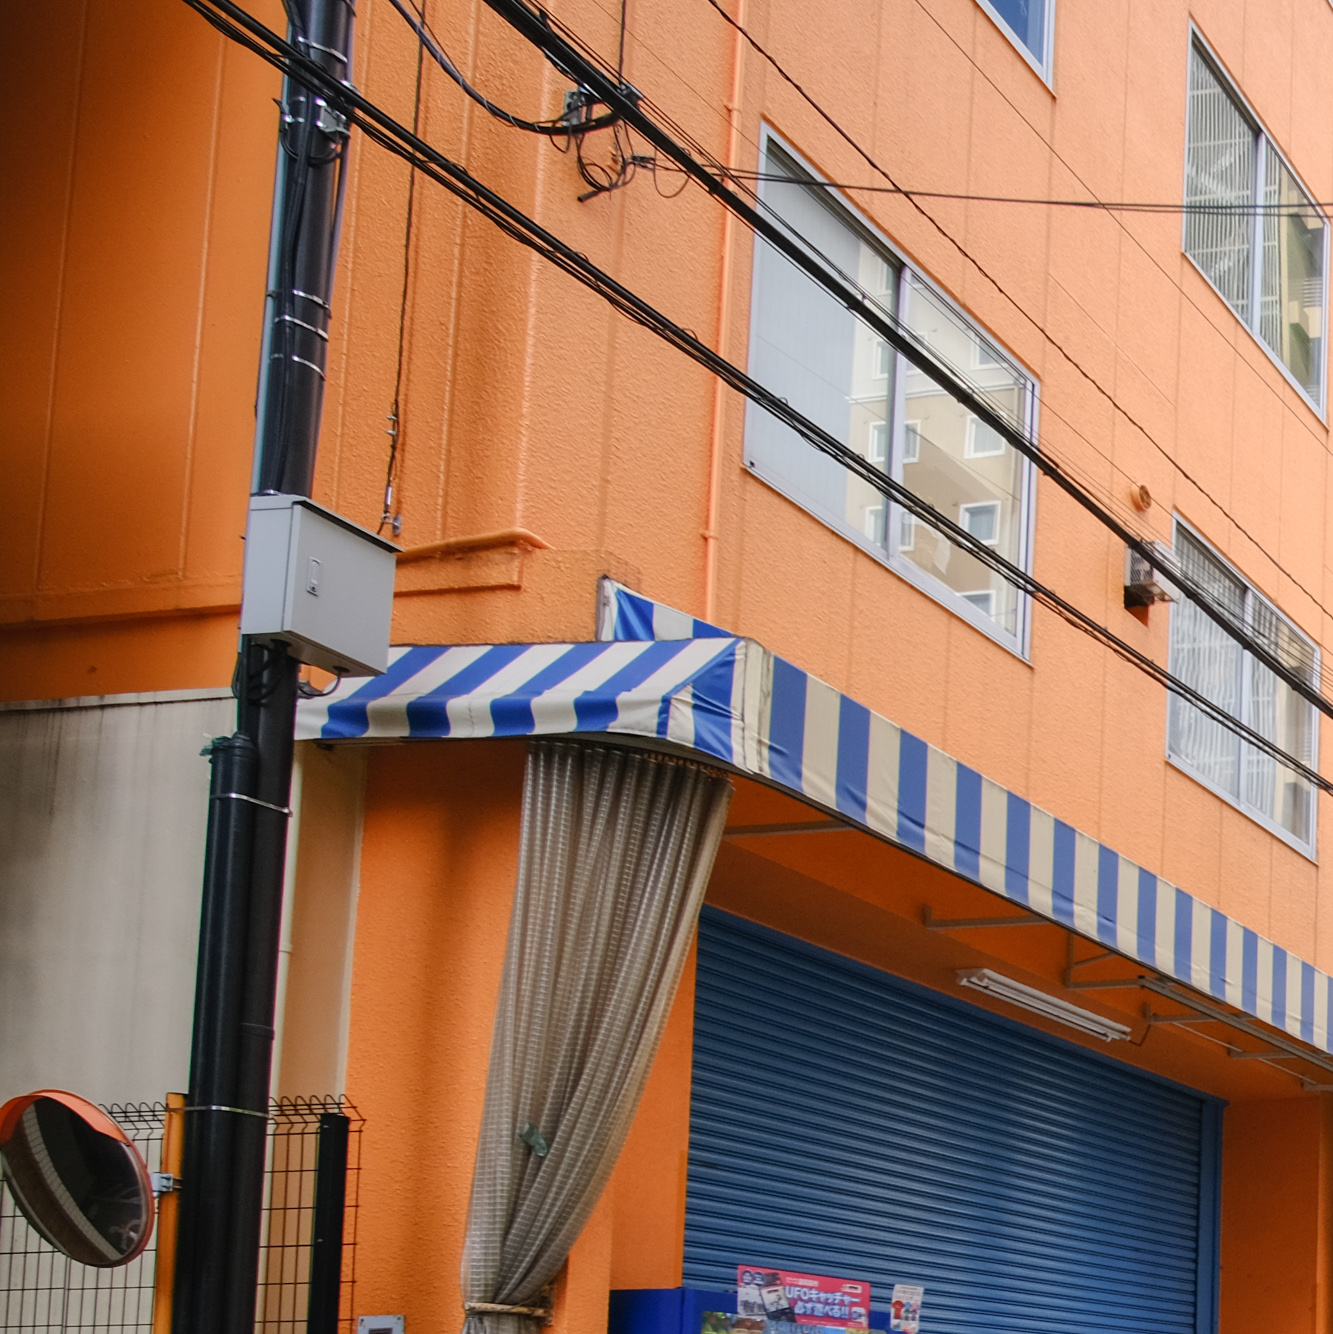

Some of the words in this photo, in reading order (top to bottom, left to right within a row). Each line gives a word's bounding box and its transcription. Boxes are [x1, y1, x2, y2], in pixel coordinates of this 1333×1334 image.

[785, 1286, 861, 1304] UFOキャッチャー
